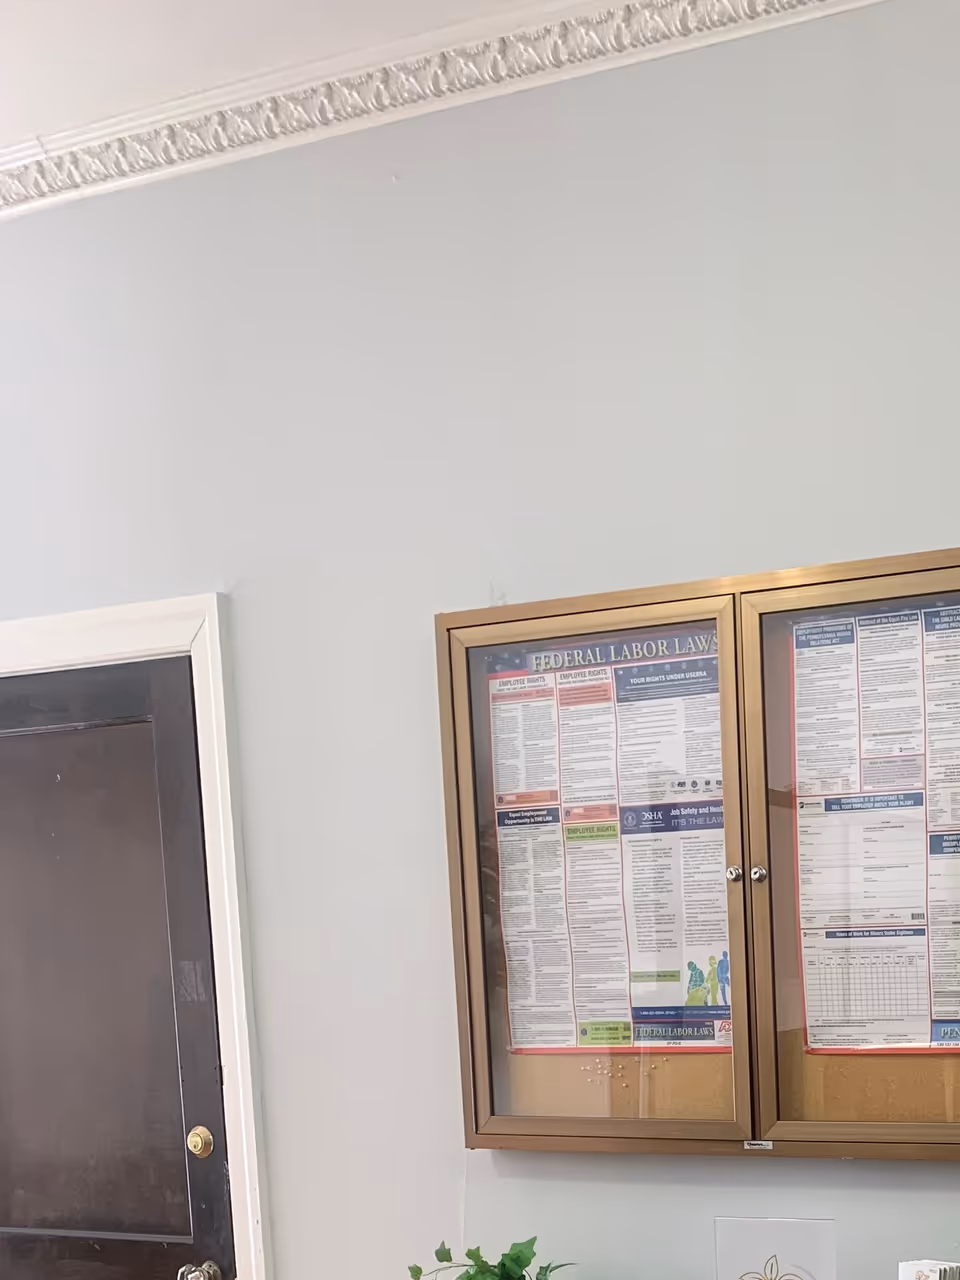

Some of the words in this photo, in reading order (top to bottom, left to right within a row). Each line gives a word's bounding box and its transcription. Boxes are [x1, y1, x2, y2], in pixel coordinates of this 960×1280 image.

[532, 647, 606, 672] FEDERAL
[609, 639, 670, 661] LABOR
[560, 672, 588, 681] EMPLOYEE
[588, 668, 608, 677] RIGHTS
[645, 675, 666, 683] RIGHTS
[666, 673, 685, 681] UNDER
[499, 677, 526, 687] EMPLOYEE
[670, 808, 680, 816] Job
[680, 807, 698, 816] Safety
[698, 806, 709, 814] and
[689, 817, 705, 825] THE
[567, 826, 596, 835] EMPLOYEE
[596, 825, 617, 833] RIGHTS
[635, 1026, 667, 1036] FEDERAL
[668, 1027, 693, 1036] LABOR
[694, 1027, 714, 1036] LAWS
[718, 1021, 731, 1032] AD
